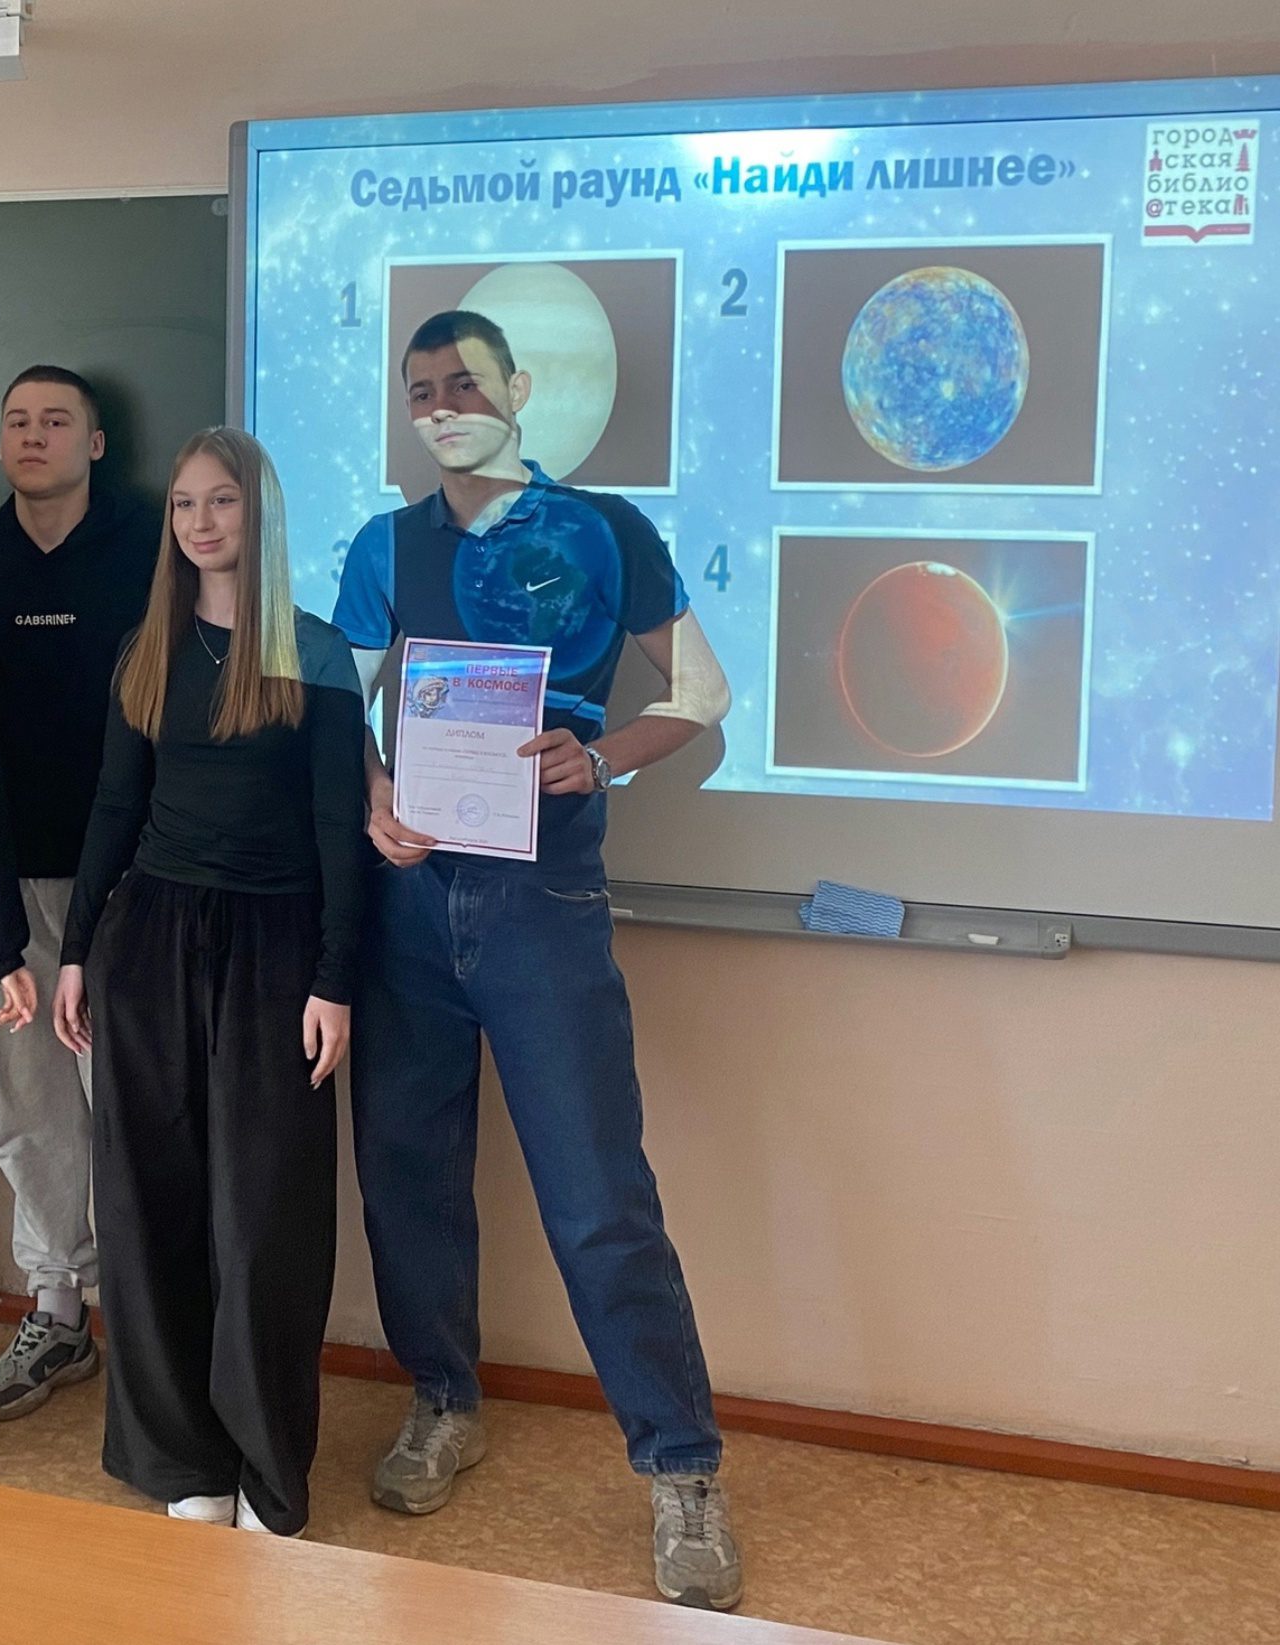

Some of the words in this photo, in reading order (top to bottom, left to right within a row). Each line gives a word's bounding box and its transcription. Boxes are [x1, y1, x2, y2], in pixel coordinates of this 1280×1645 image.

[1152, 127, 1233, 149] город
[1165, 152, 1233, 169] ская
[350, 158, 541, 212] Седьмой
[551, 166, 682, 209] раунд
[693, 150, 854, 197] «Найди
[866, 153, 1076, 190] лишнее»
[1147, 173, 1249, 194] библио
[721, 268, 748, 316] 2
[341, 281, 361, 327] 1
[704, 544, 731, 592] 4
[466, 664, 518, 678] ПЕРВЫЕ
[452, 677, 461, 687] В
[467, 678, 529, 692] КОСМОСЕ
[445, 728, 485, 740] ДИПЛОМ
